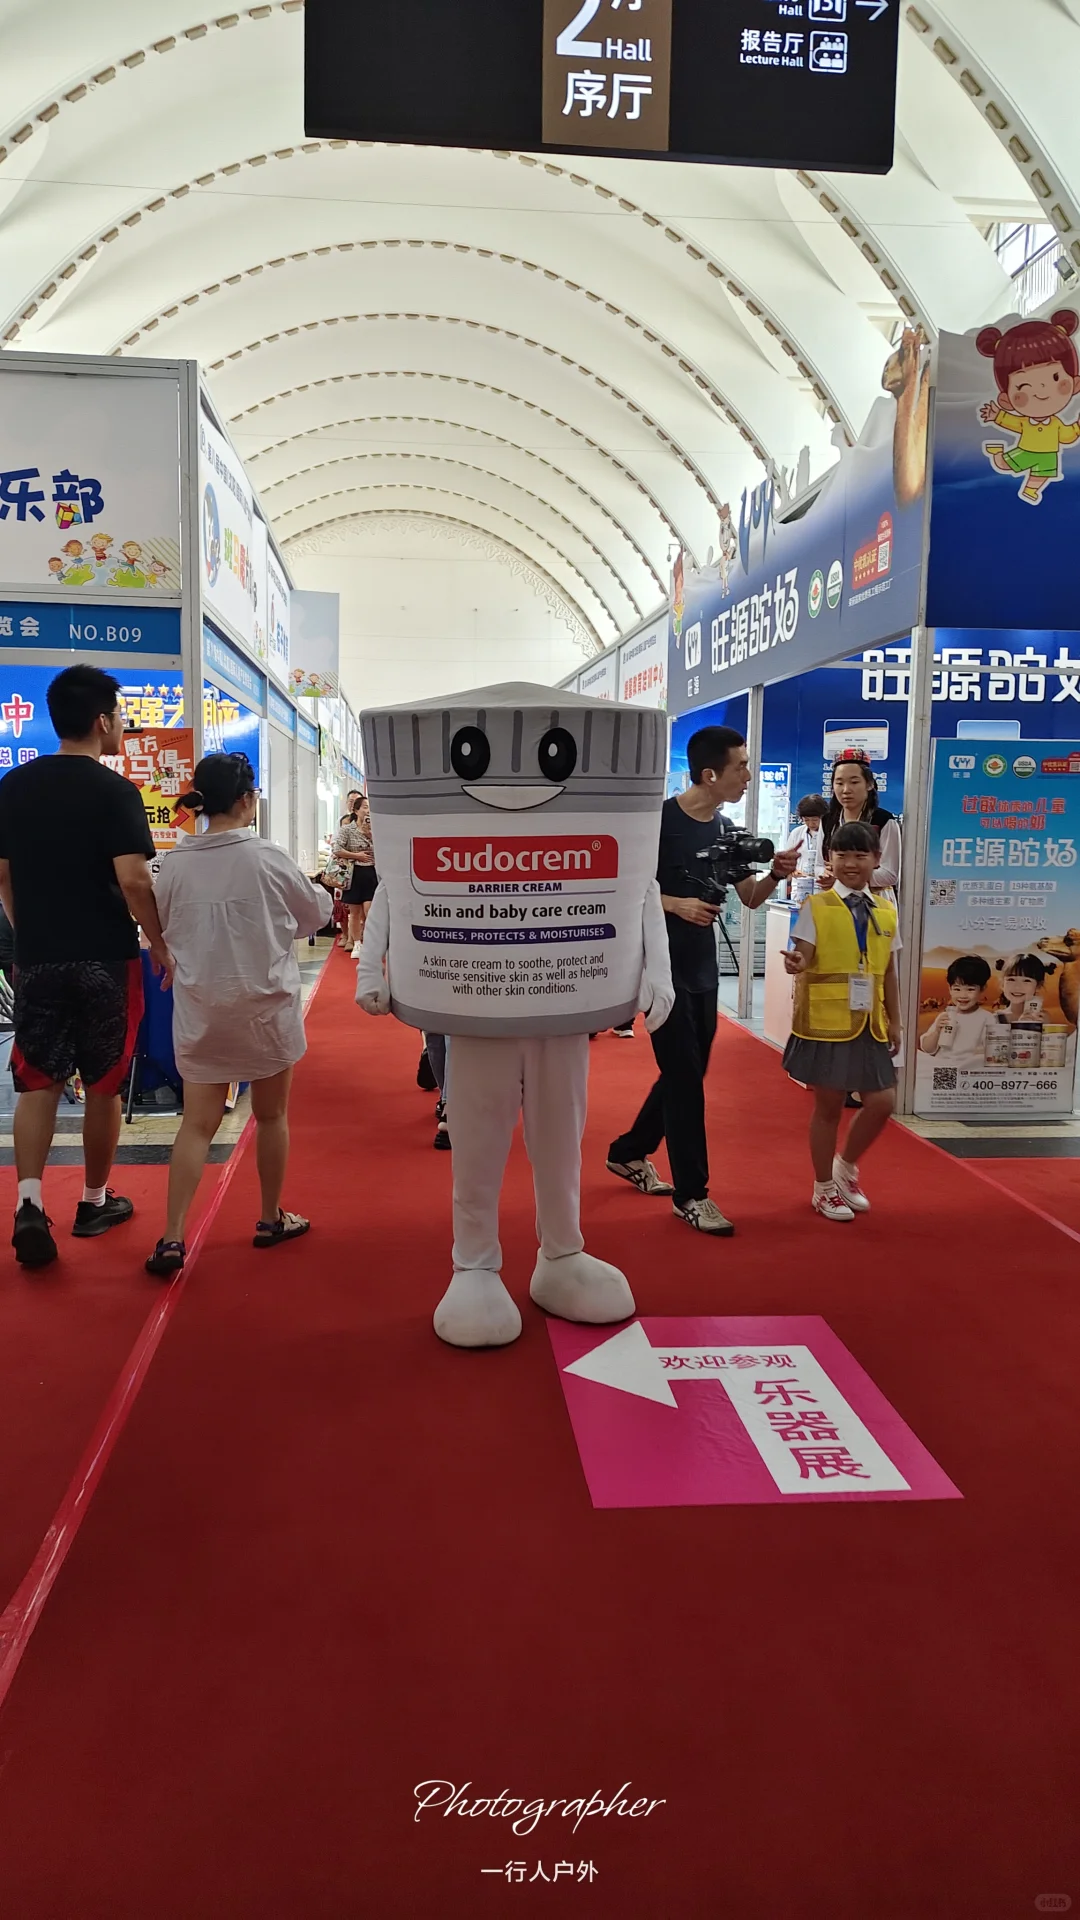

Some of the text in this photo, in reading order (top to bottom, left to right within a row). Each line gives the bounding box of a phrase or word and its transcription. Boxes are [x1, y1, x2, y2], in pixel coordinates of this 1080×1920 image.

[778, 4, 803, 16] Hall
[606, 38, 652, 61] Hall
[740, 28, 804, 54] 报告厅
[740, 53, 804, 67] Lecture Hall
[562, 69, 653, 120] 序厅
[69, 623, 142, 644] NO.B09
[1, 694, 34, 738] 中
[124, 735, 158, 757] 魔方
[962, 795, 1066, 814] 过敏体质的儿童
[980, 815, 1047, 830] 可以喝的奶
[436, 843, 592, 872] Sudocrem
[468, 882, 563, 894] BARRIER CREAM
[962, 881, 1054, 890] 优质乳蛋白 19种氨基酸
[970, 896, 1044, 906] 多种维生素 矿物质
[424, 903, 606, 921] Skin and baby care cream
[421, 927, 605, 941] SOOTHES, PROTECTS & MOISTURISES
[423, 952, 604, 972] A skin care cream to soothe, protect and
[419, 965, 608, 983] moisturise sensitive skin as well as helping
[452, 982, 578, 996] with other skin conditions.
[972, 1080, 1058, 1090] 400-8977-666
[657, 1353, 798, 1370] 欢迎参观
[752, 1378, 872, 1481] 乐器展
